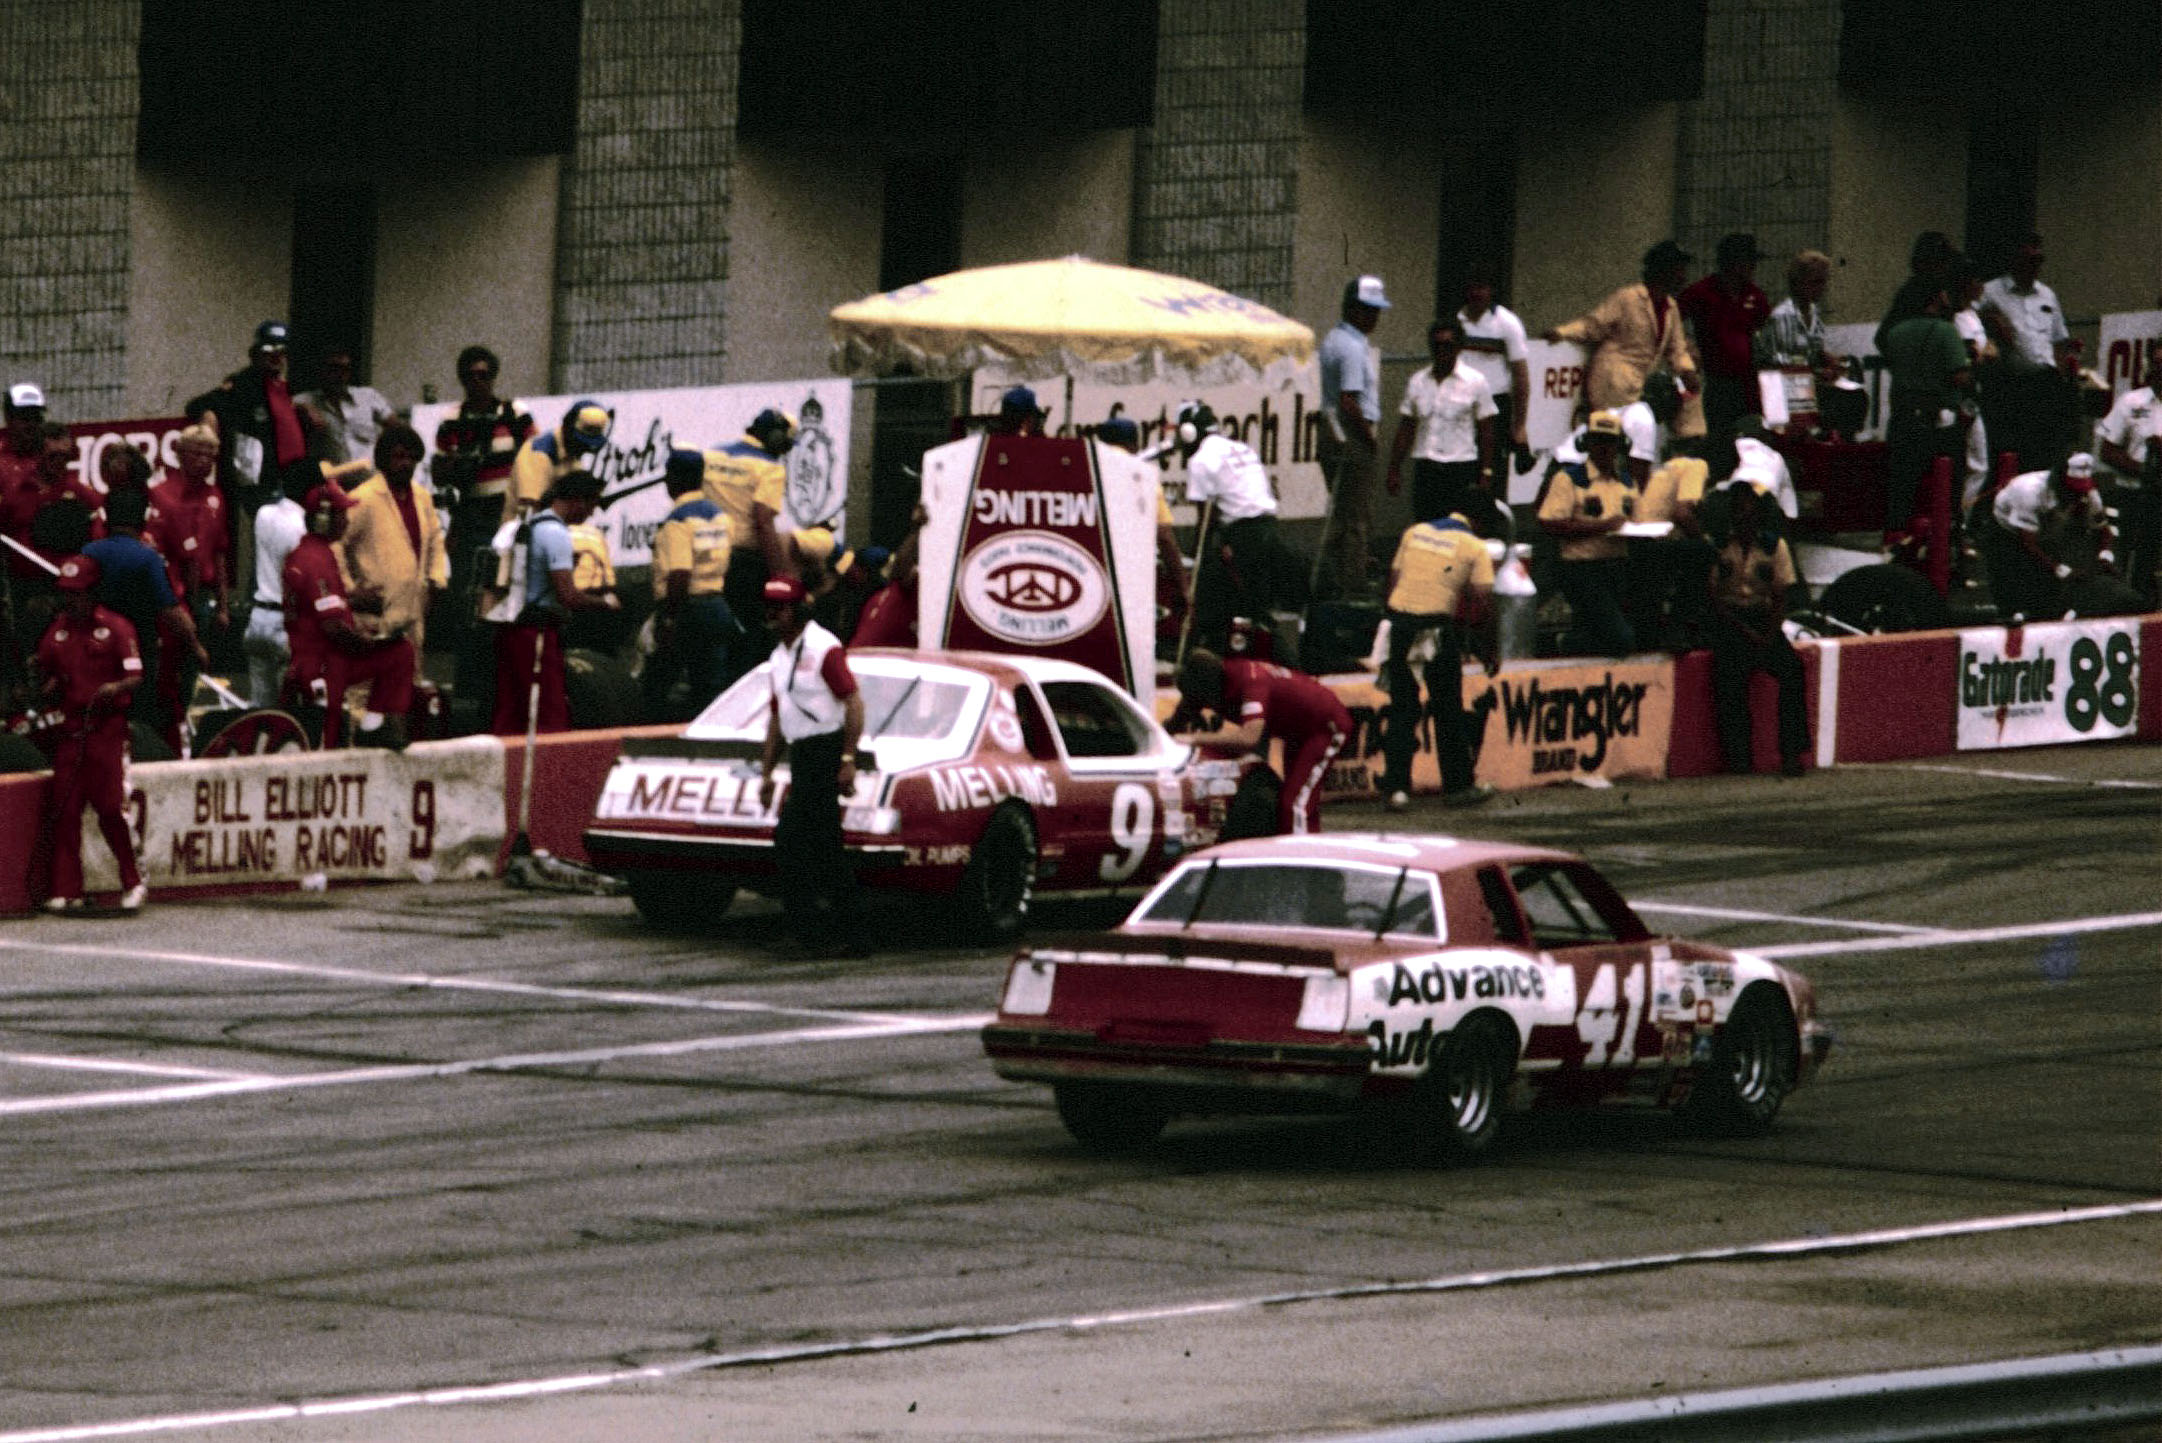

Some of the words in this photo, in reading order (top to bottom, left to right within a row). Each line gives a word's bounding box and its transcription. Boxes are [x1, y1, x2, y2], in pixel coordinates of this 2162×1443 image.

[975, 488, 1097, 527] MELLING
[1500, 671, 1648, 773] Wrangler
[2064, 631, 2135, 733] 88
[194, 779, 250, 825] BILL
[264, 773, 368, 822] ELLIOTT
[409, 779, 436, 860] 9
[1099, 782, 1155, 882] 9
[171, 827, 276, 877] MELLING
[296, 825, 387, 871] RACING
[1387, 960, 1546, 1008] Advance
[1576, 962, 1647, 1065] 41
